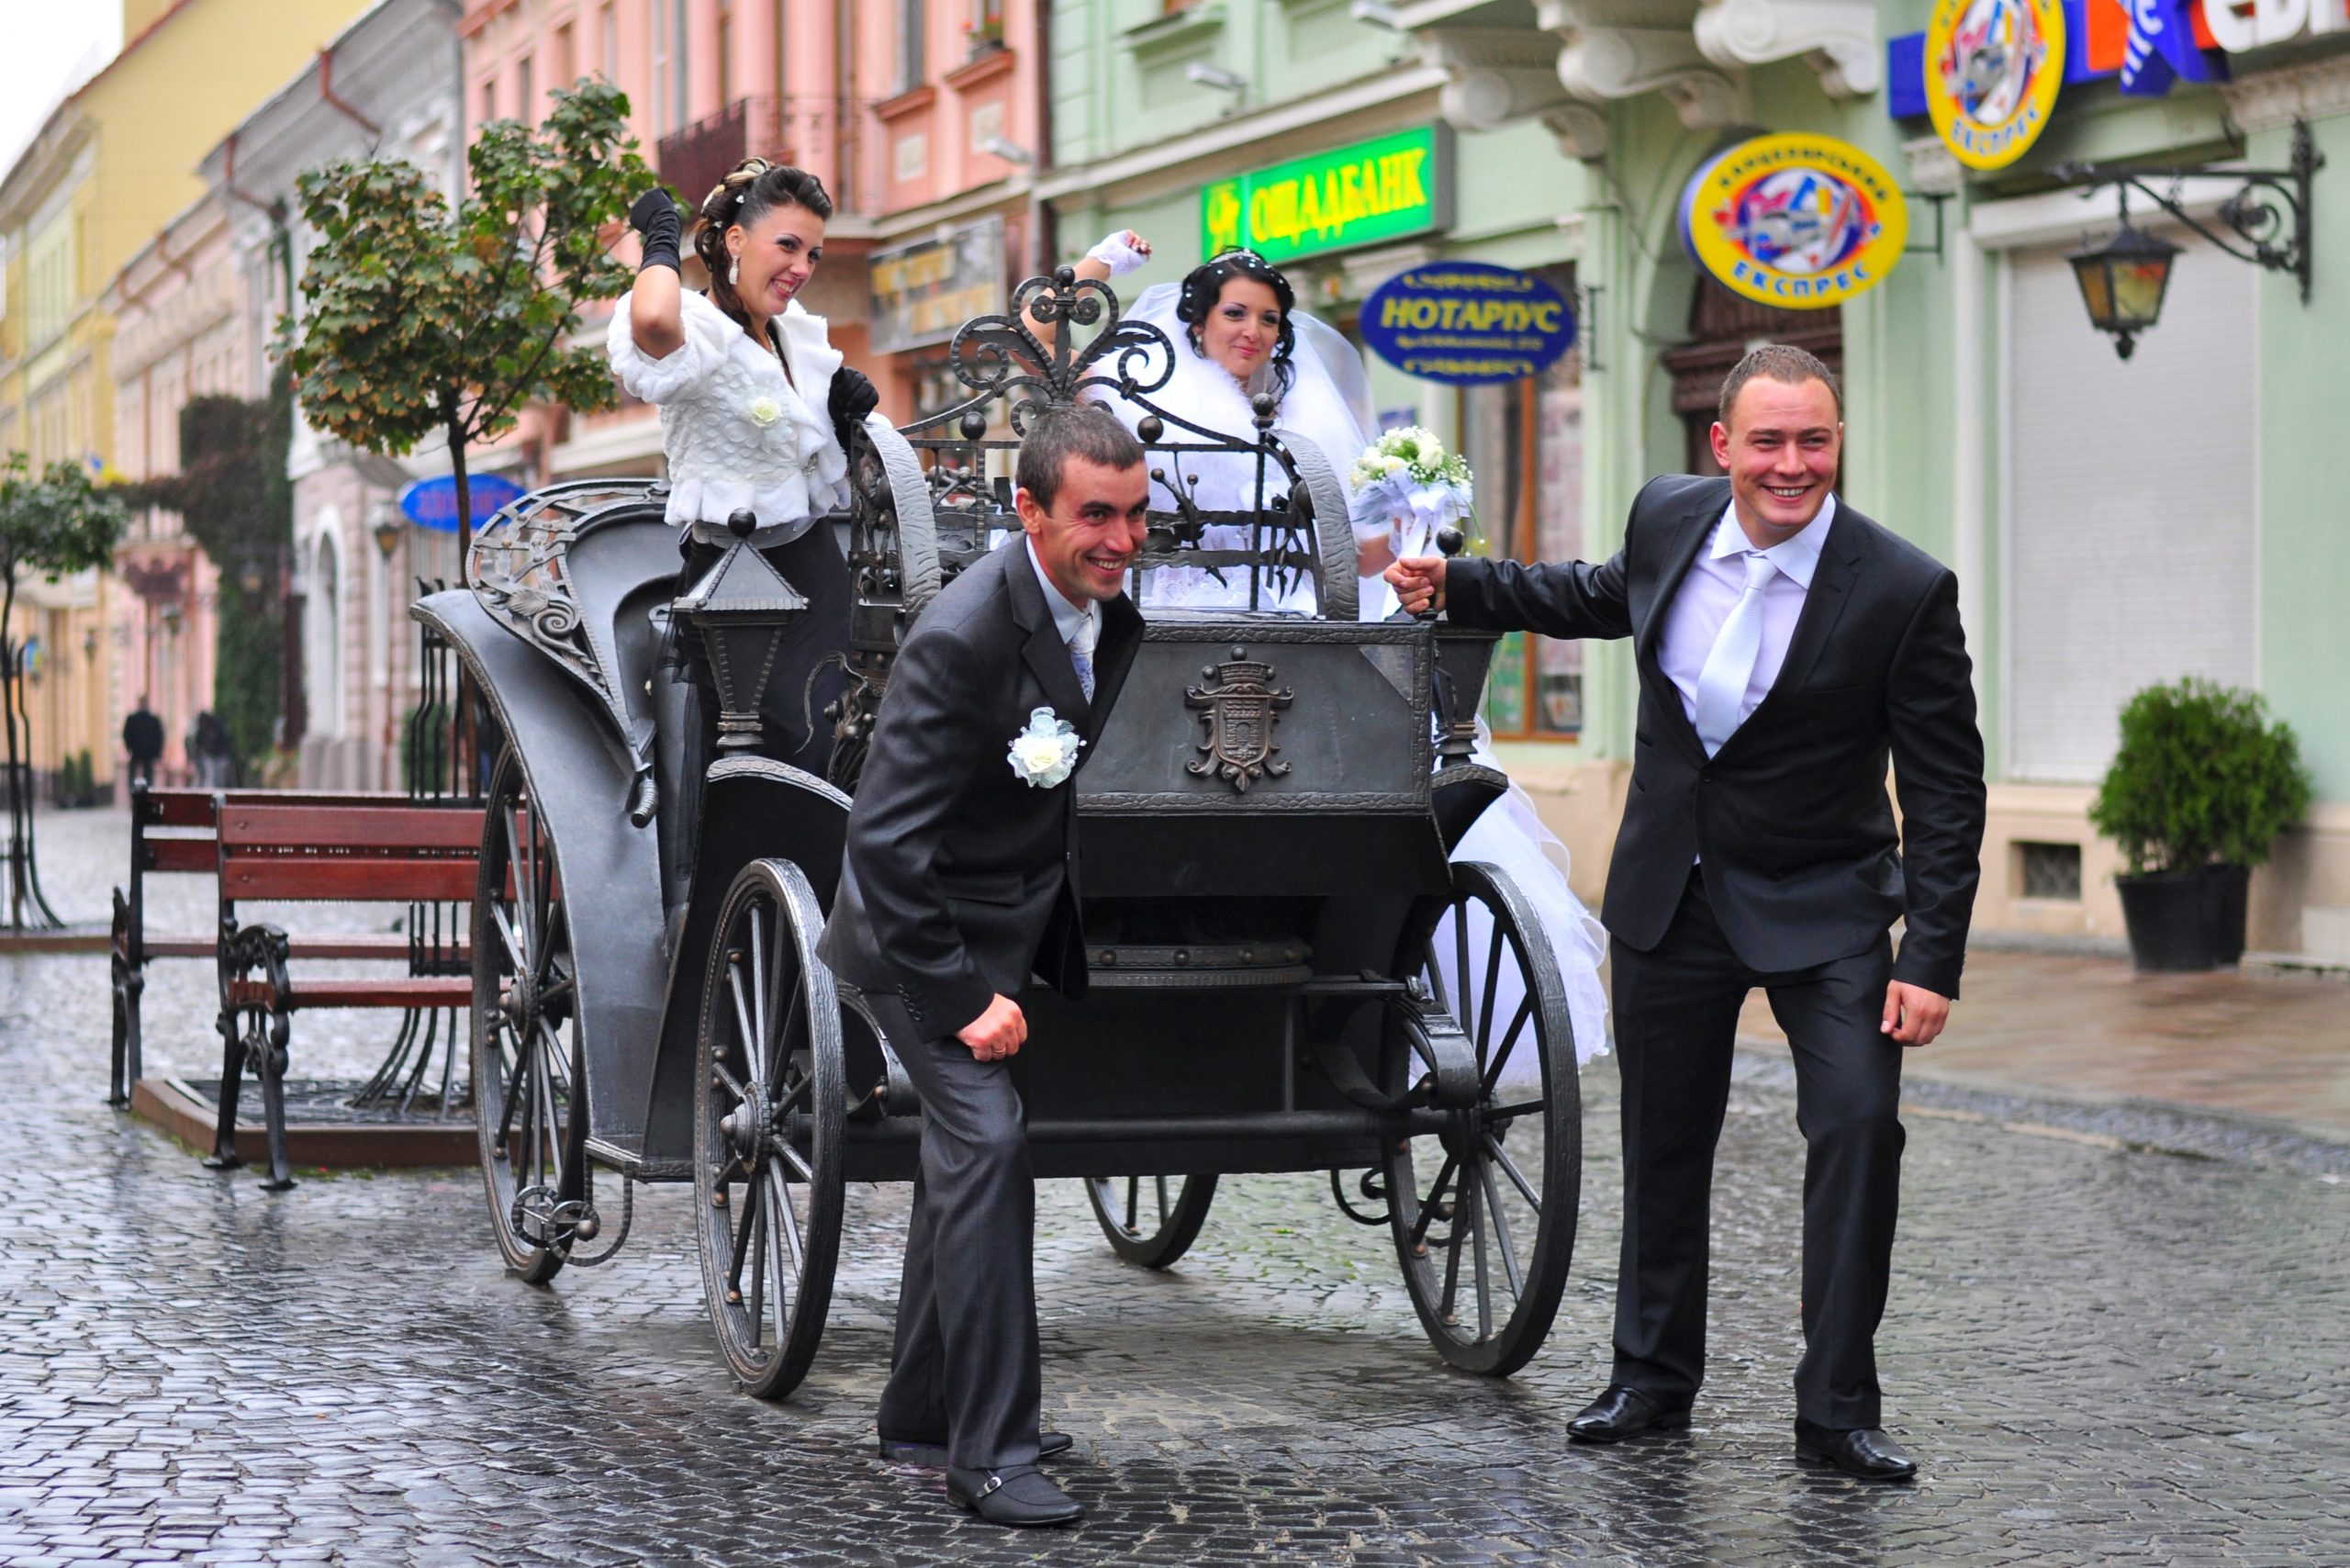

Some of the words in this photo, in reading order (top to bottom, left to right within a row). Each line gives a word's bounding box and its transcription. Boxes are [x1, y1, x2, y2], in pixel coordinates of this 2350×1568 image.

[1249, 147, 1426, 246] ОЩАДБАНК
[1733, 260, 1869, 296] ЕКСПРЕС
[1380, 296, 1561, 333] НОТАРІУС
